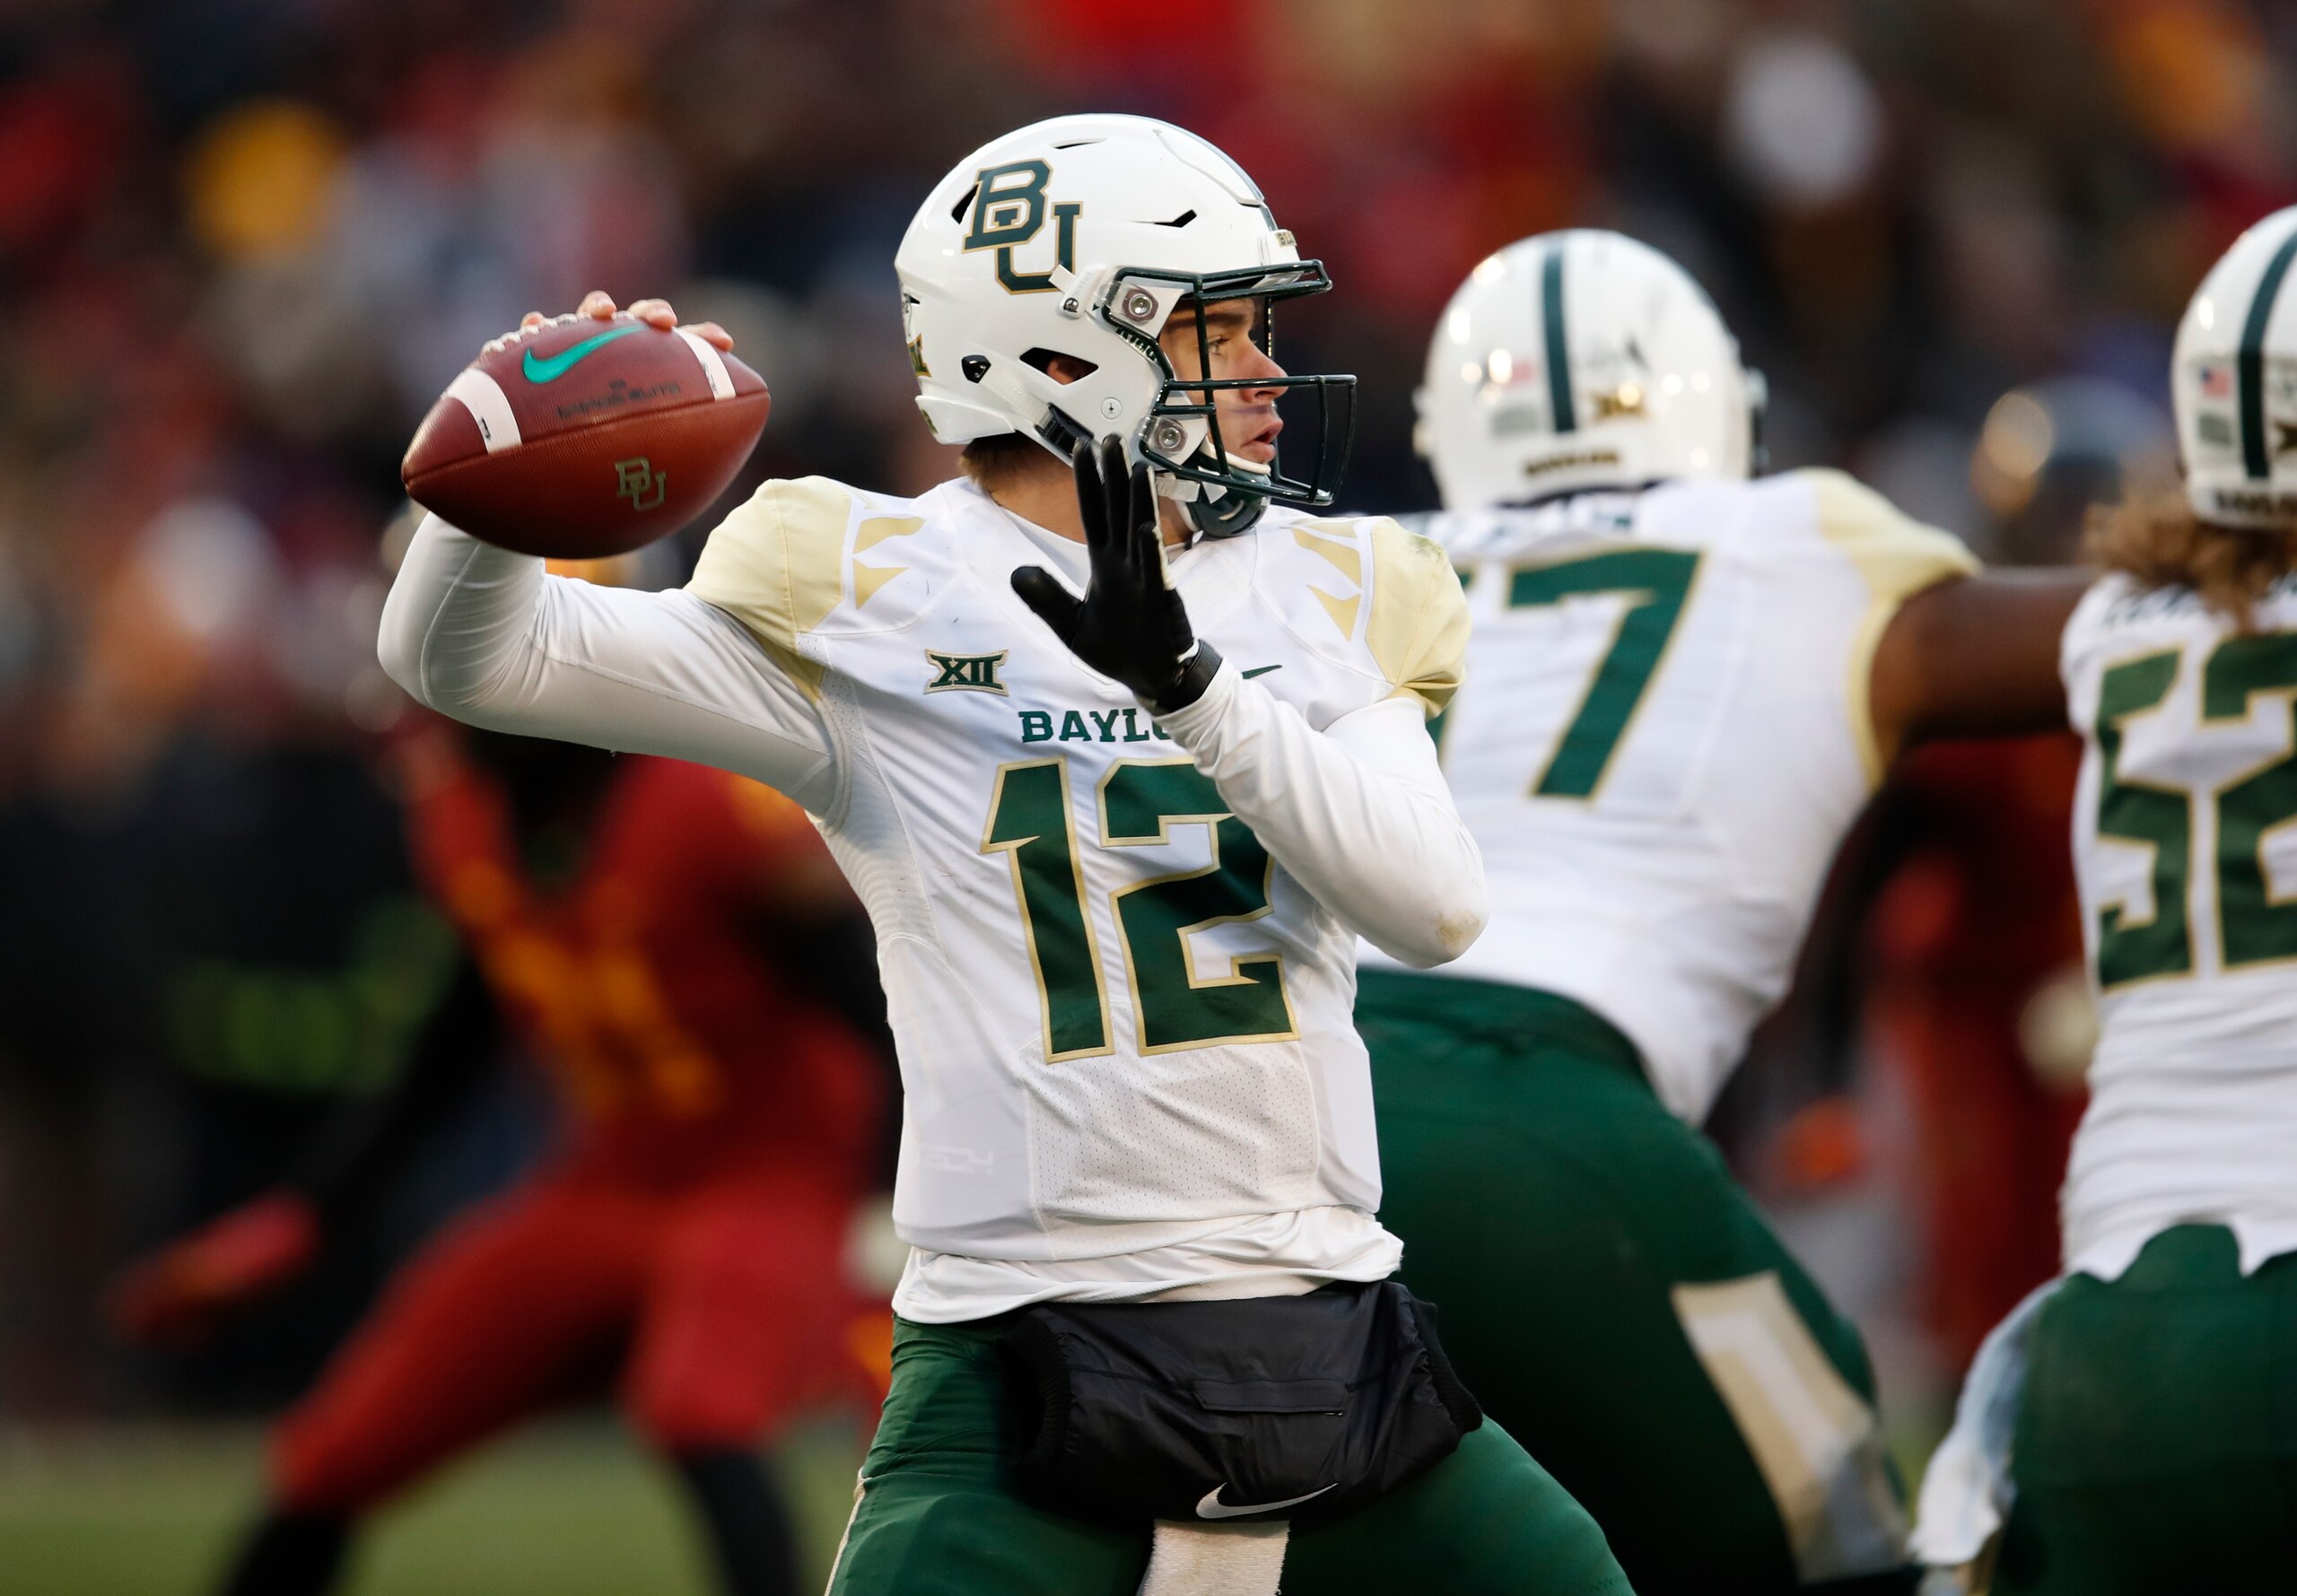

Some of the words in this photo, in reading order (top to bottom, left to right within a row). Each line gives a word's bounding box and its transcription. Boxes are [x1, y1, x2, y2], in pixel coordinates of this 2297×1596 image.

[962, 158, 1083, 294] BU
[614, 457, 667, 511] BU
[927, 651, 1007, 693] XII
[1425, 545, 1708, 806] 7
[980, 754, 1300, 1064] 12
[2095, 630, 2297, 995] 52
